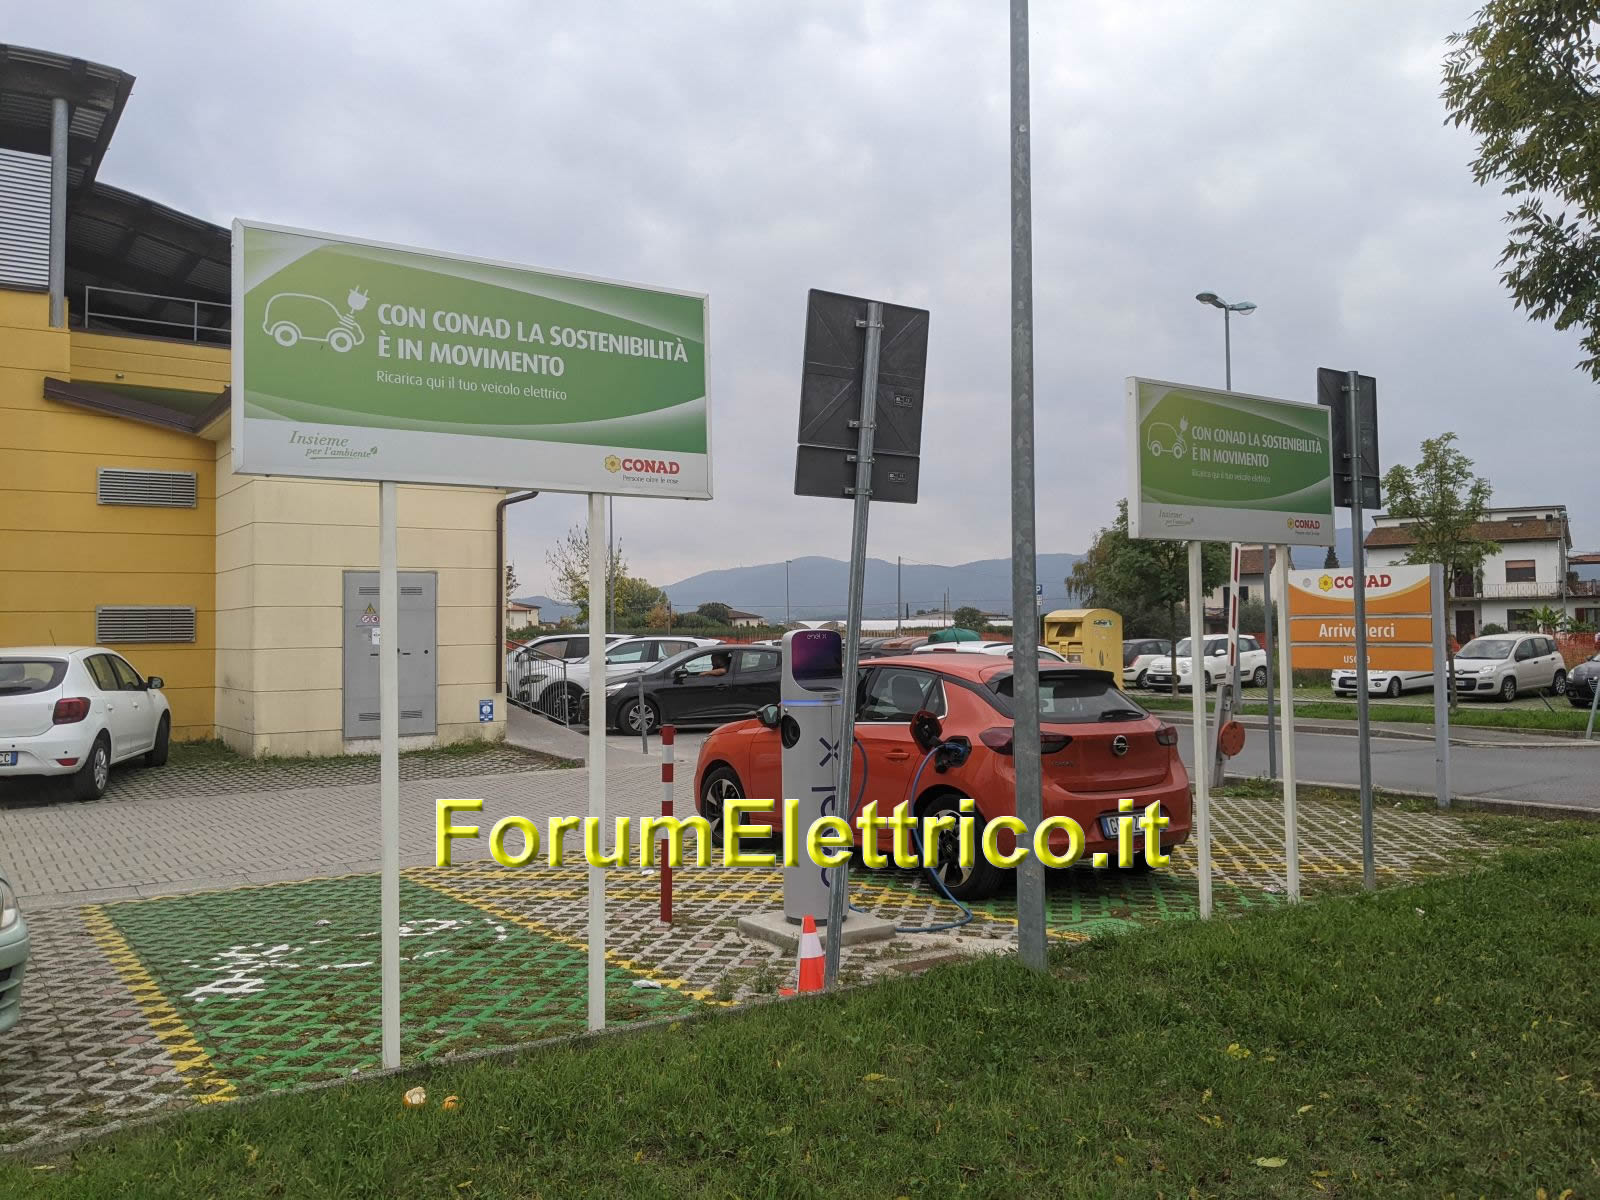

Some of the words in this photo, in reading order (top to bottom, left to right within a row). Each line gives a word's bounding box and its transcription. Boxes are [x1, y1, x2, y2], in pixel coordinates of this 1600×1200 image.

[378, 303, 426, 329] CON
[432, 310, 511, 340] CONAD
[517, 321, 545, 344] LA
[550, 325, 689, 363] SOSTENIBILITÀ
[378, 329, 391, 358] È
[397, 338, 423, 361] IN
[430, 342, 565, 377] MOVIMENTO
[376, 370, 423, 386] Ricarica
[426, 376, 445, 390] qui
[448, 376, 455, 389] il
[459, 378, 478, 392] tuo
[481, 382, 520, 396] veicolo
[523, 385, 567, 400] elettrico
[288, 430, 349, 447] Insieme
[1191, 426, 1212, 441] CON
[1214, 428, 1246, 446] CONAD
[1248, 431, 1260, 447] LA
[1262, 434, 1322, 454] SOSTENIBILITÀ
[305, 447, 322, 456] per
[324, 446, 371, 458] l'ambiente
[1192, 443, 1198, 461] È
[1200, 448, 1211, 461] IN
[1213, 449, 1269, 468] MOVIMENTO
[622, 458, 680, 475] CONAD
[1294, 519, 1320, 529] CONAD
[1334, 574, 1391, 589] COAD
[1319, 623, 1395, 638] Arriveerci
